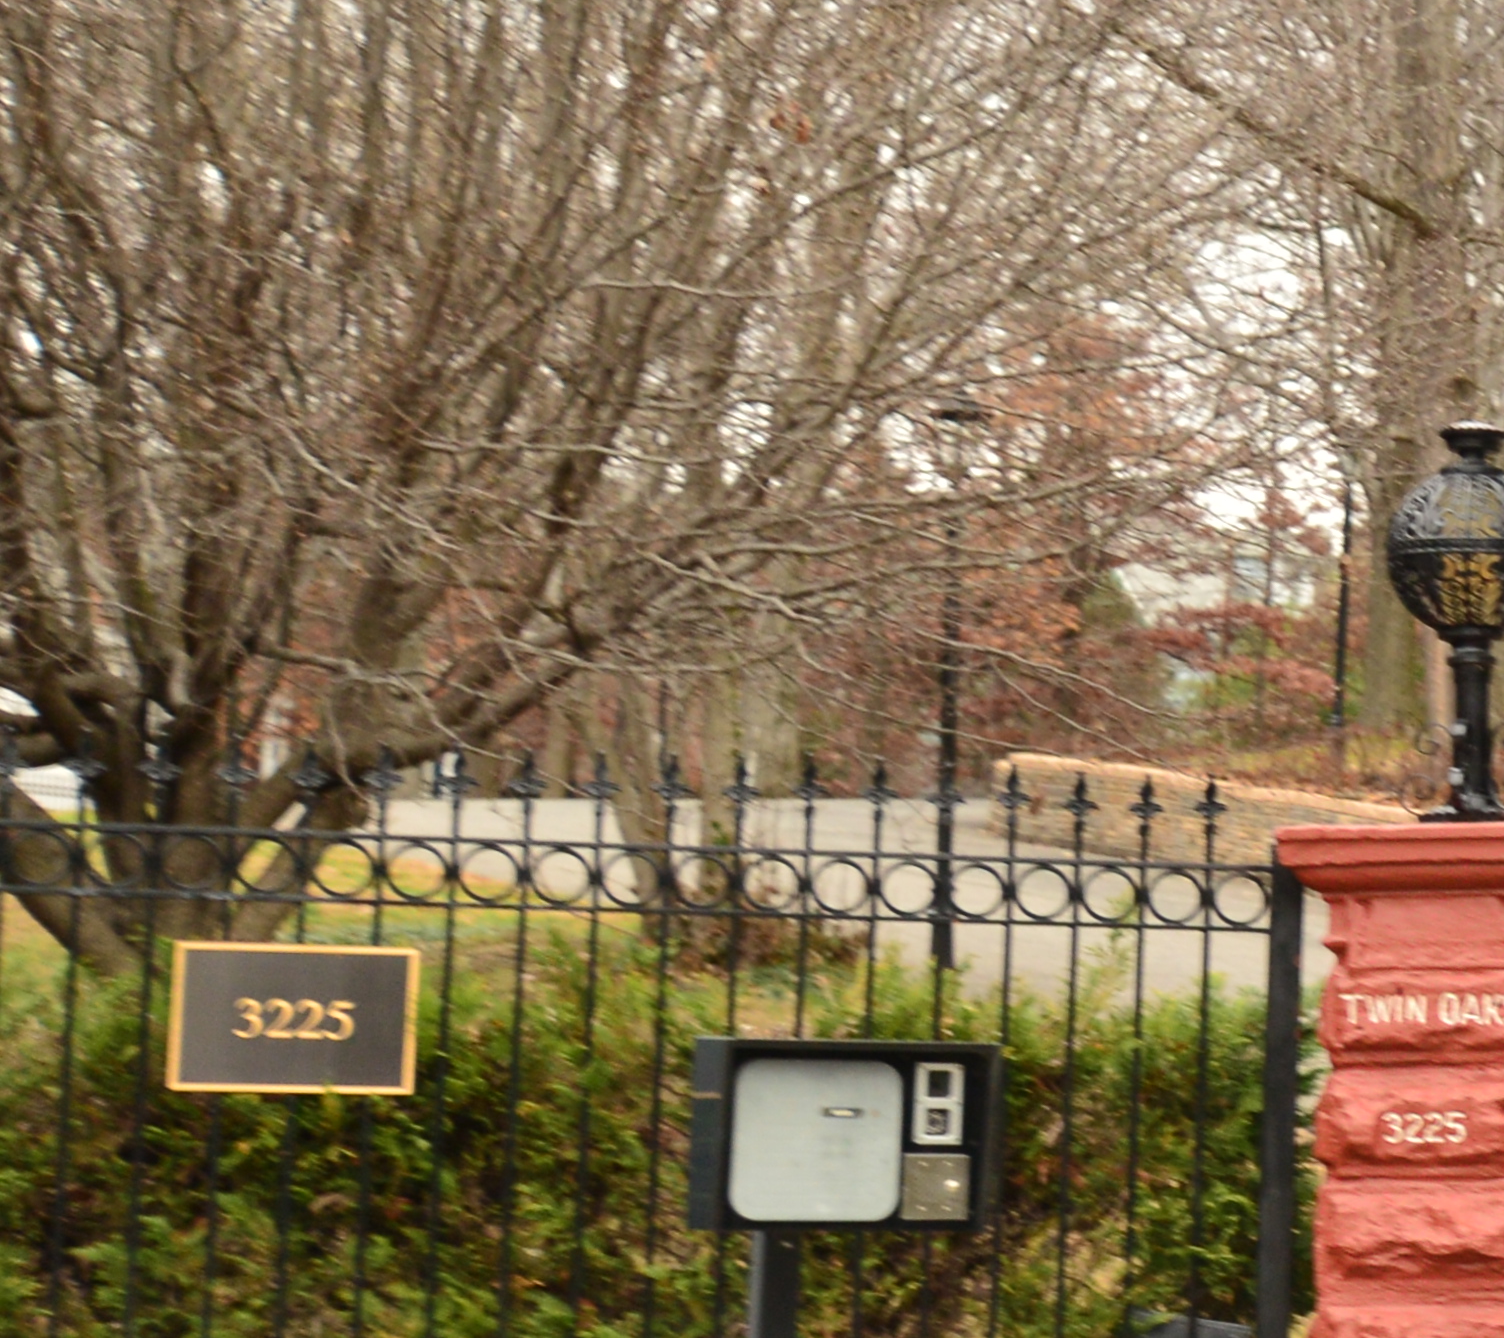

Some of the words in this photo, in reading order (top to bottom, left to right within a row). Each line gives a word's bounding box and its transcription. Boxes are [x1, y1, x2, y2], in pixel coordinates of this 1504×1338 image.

[230, 996, 358, 1042] 3225
[1338, 992, 1428, 1025] TWIN
[1379, 1110, 1469, 1145] 3225
